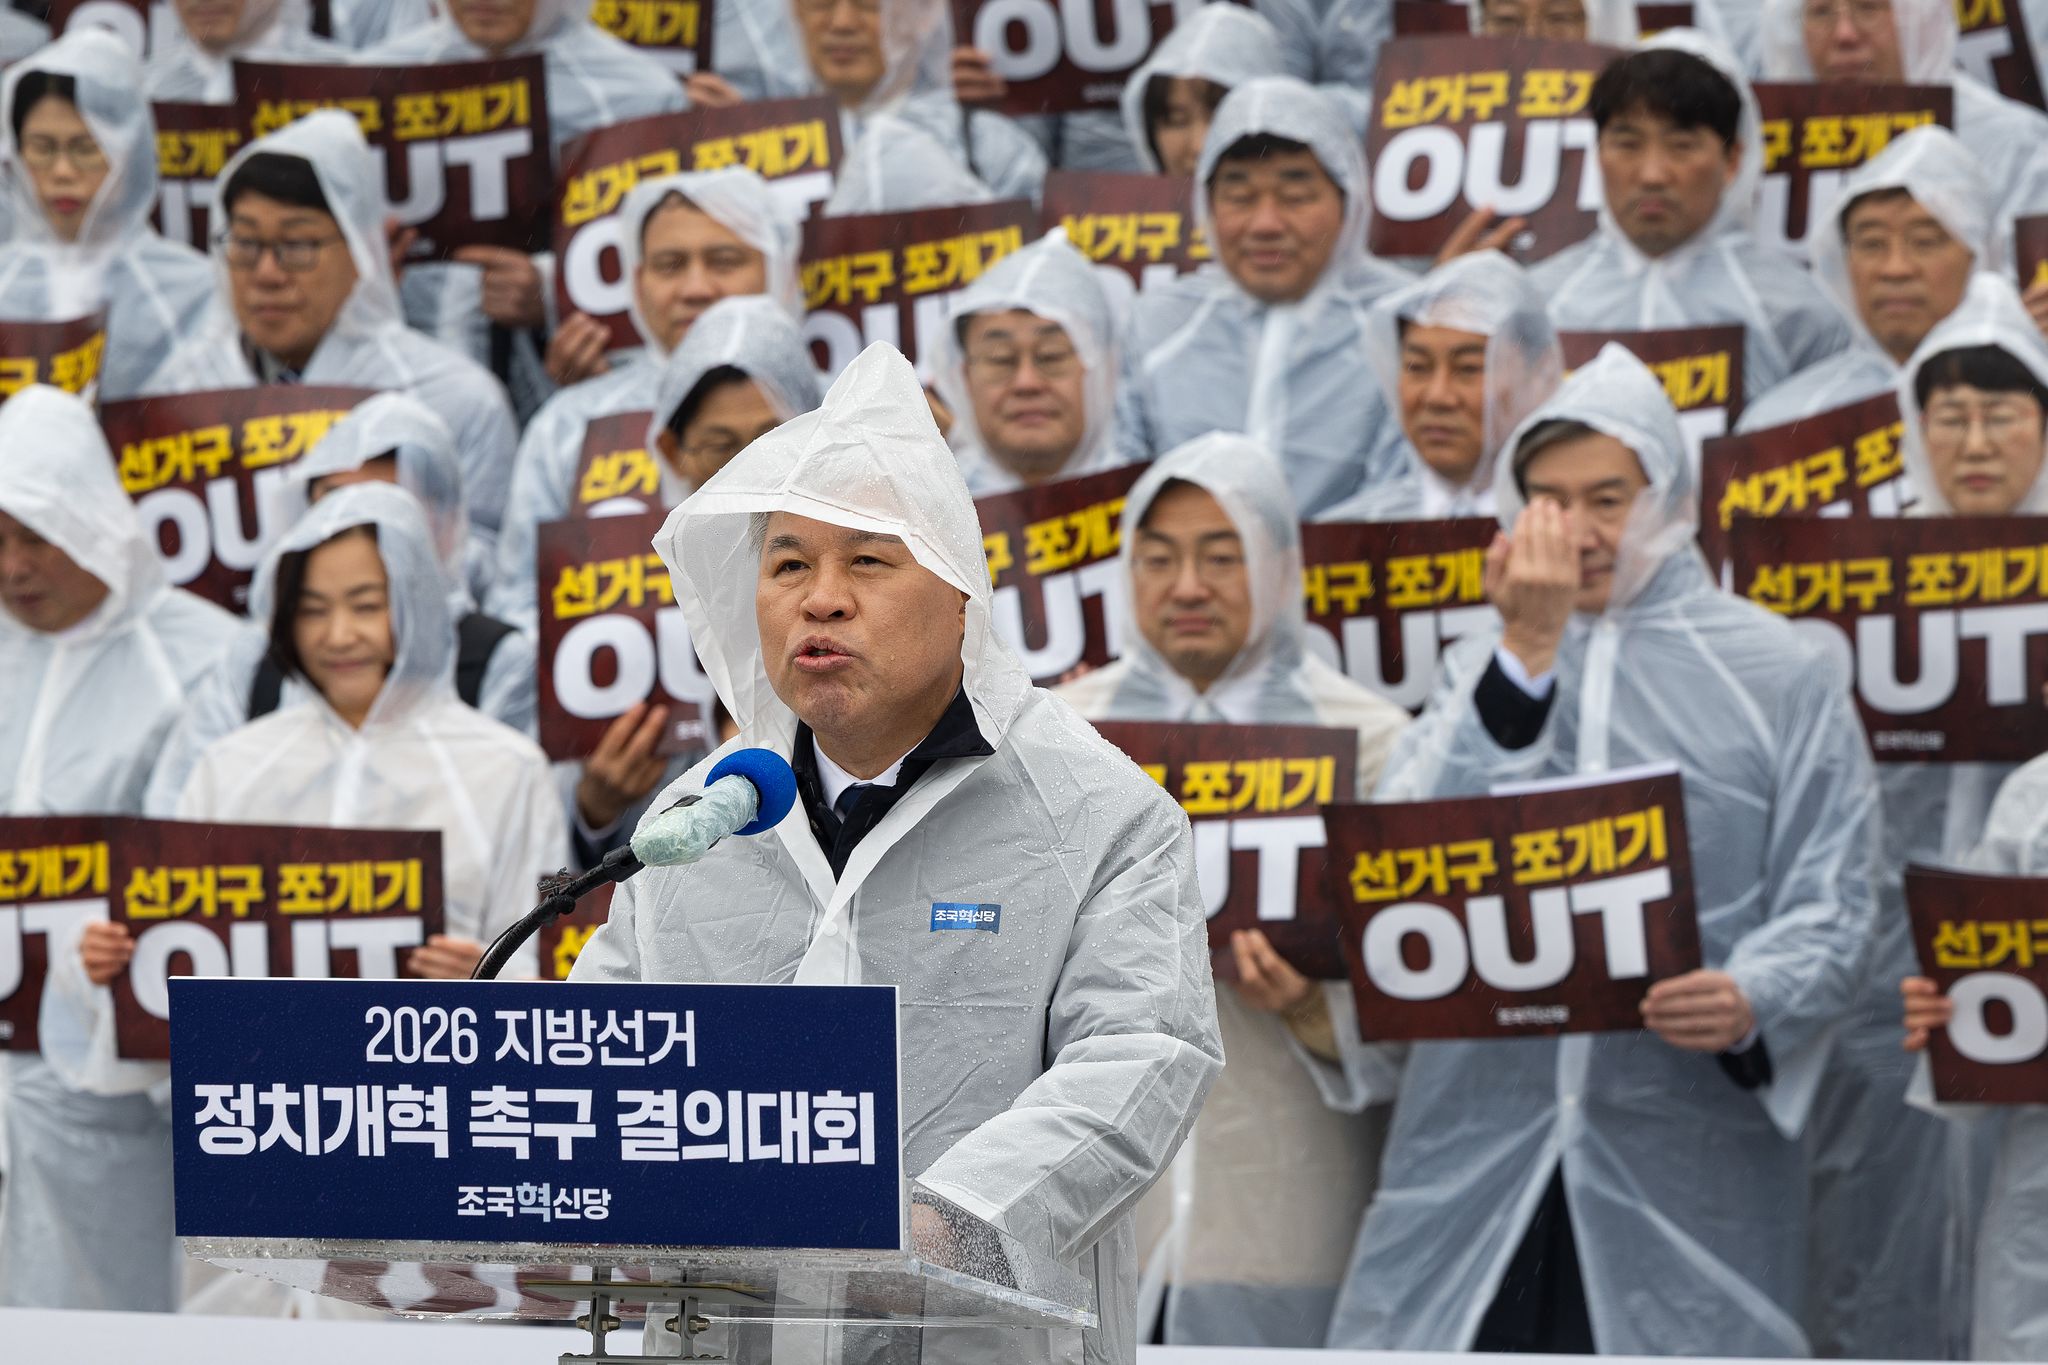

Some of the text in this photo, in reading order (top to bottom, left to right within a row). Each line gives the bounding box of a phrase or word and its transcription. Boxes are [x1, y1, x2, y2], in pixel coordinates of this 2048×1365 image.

[393, 77, 530, 140] 쪼개기
[1382, 71, 1510, 128] 선거구
[365, 128, 532, 226] UT
[1373, 118, 1603, 221] OUT
[800, 252, 893, 310] 거구
[119, 410, 348, 492] 선거구 쪼개
[580, 450, 660, 502] 선거
[137, 465, 290, 586] OU
[1304, 547, 1486, 615] 거구 쪼개
[1748, 558, 1892, 616] 선거구
[1182, 756, 1335, 815] 쪼개기
[1350, 806, 1667, 902] 선거구 쪼개기
[125, 859, 421, 917] 선거구 쪼개기
[935, 910, 995, 923] 조국혁신당
[1362, 866, 1672, 1000] OUT
[365, 1006, 695, 1067] 2026 지방선거
[195, 1083, 876, 1165] 정치개혁 촉구 결의대회
[457, 1181, 612, 1222] 조국혁신당
